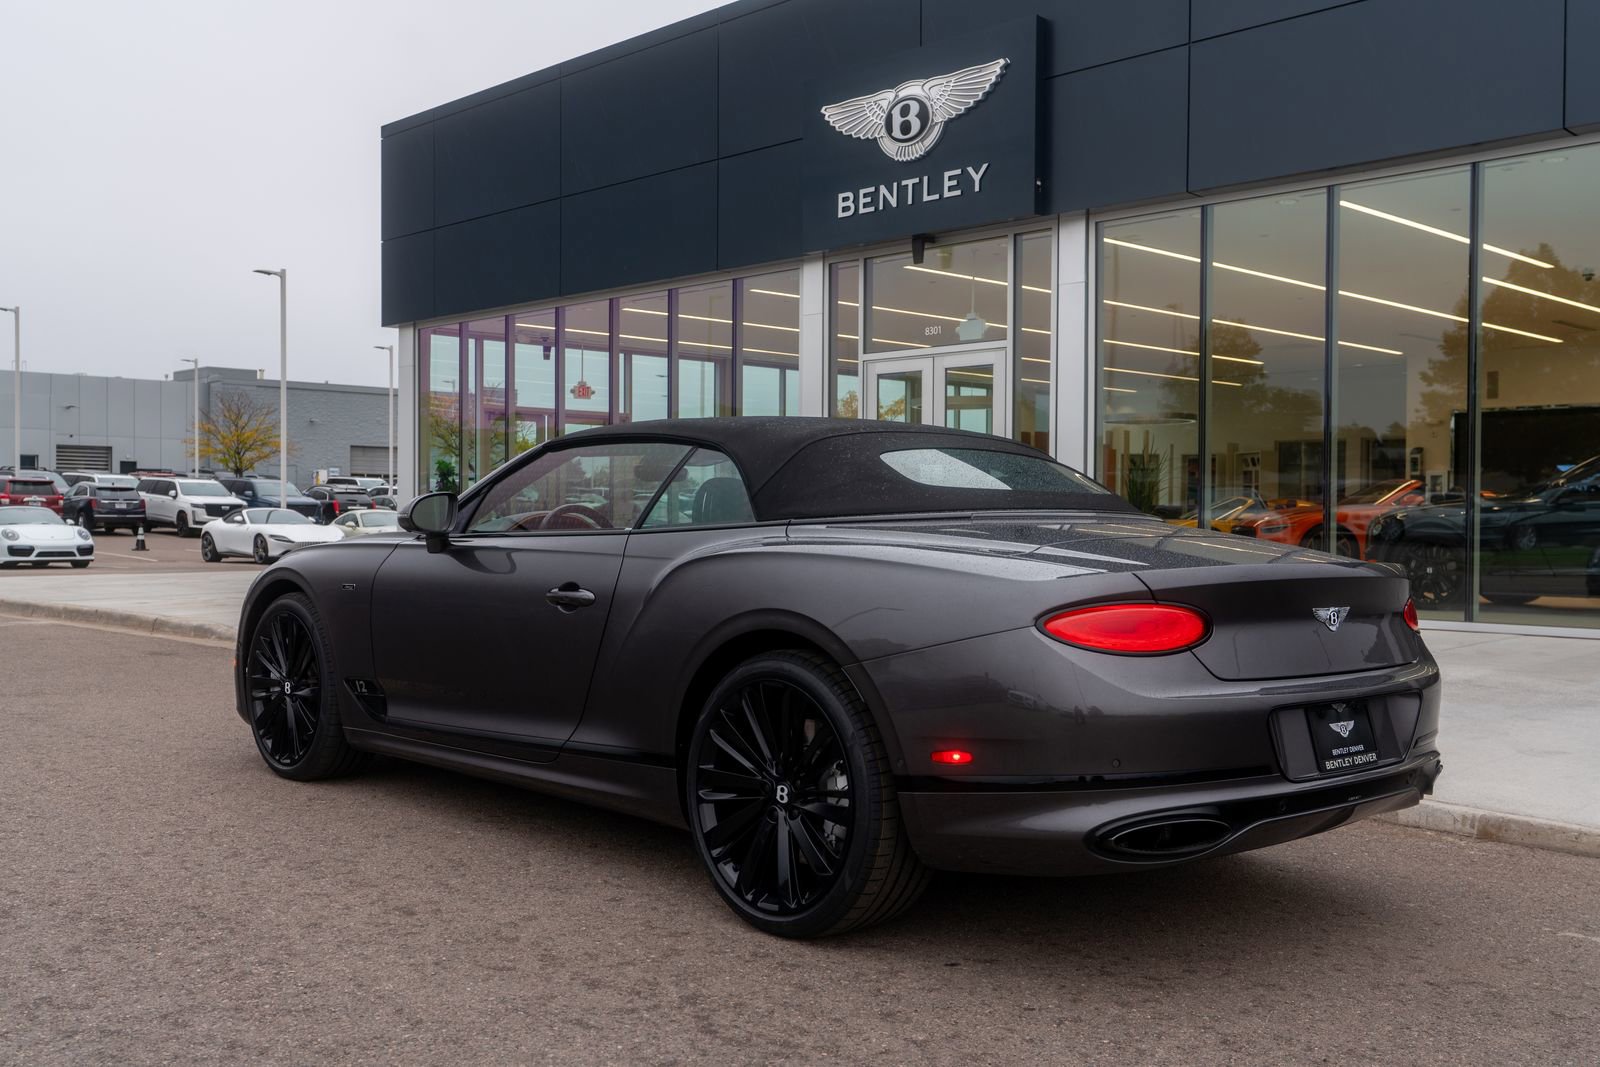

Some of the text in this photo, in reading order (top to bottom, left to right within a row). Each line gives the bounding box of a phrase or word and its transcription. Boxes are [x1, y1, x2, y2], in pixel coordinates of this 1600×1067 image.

[891, 99, 921, 140] B
[837, 162, 990, 219] BENTLEY
[924, 325, 942, 337] 8301
[1330, 611, 1338, 625] B
[1331, 744, 1365, 756] BENTLEY DENVER
[1325, 752, 1378, 770] BENTLEY DENVER
[776, 784, 789, 804] B
